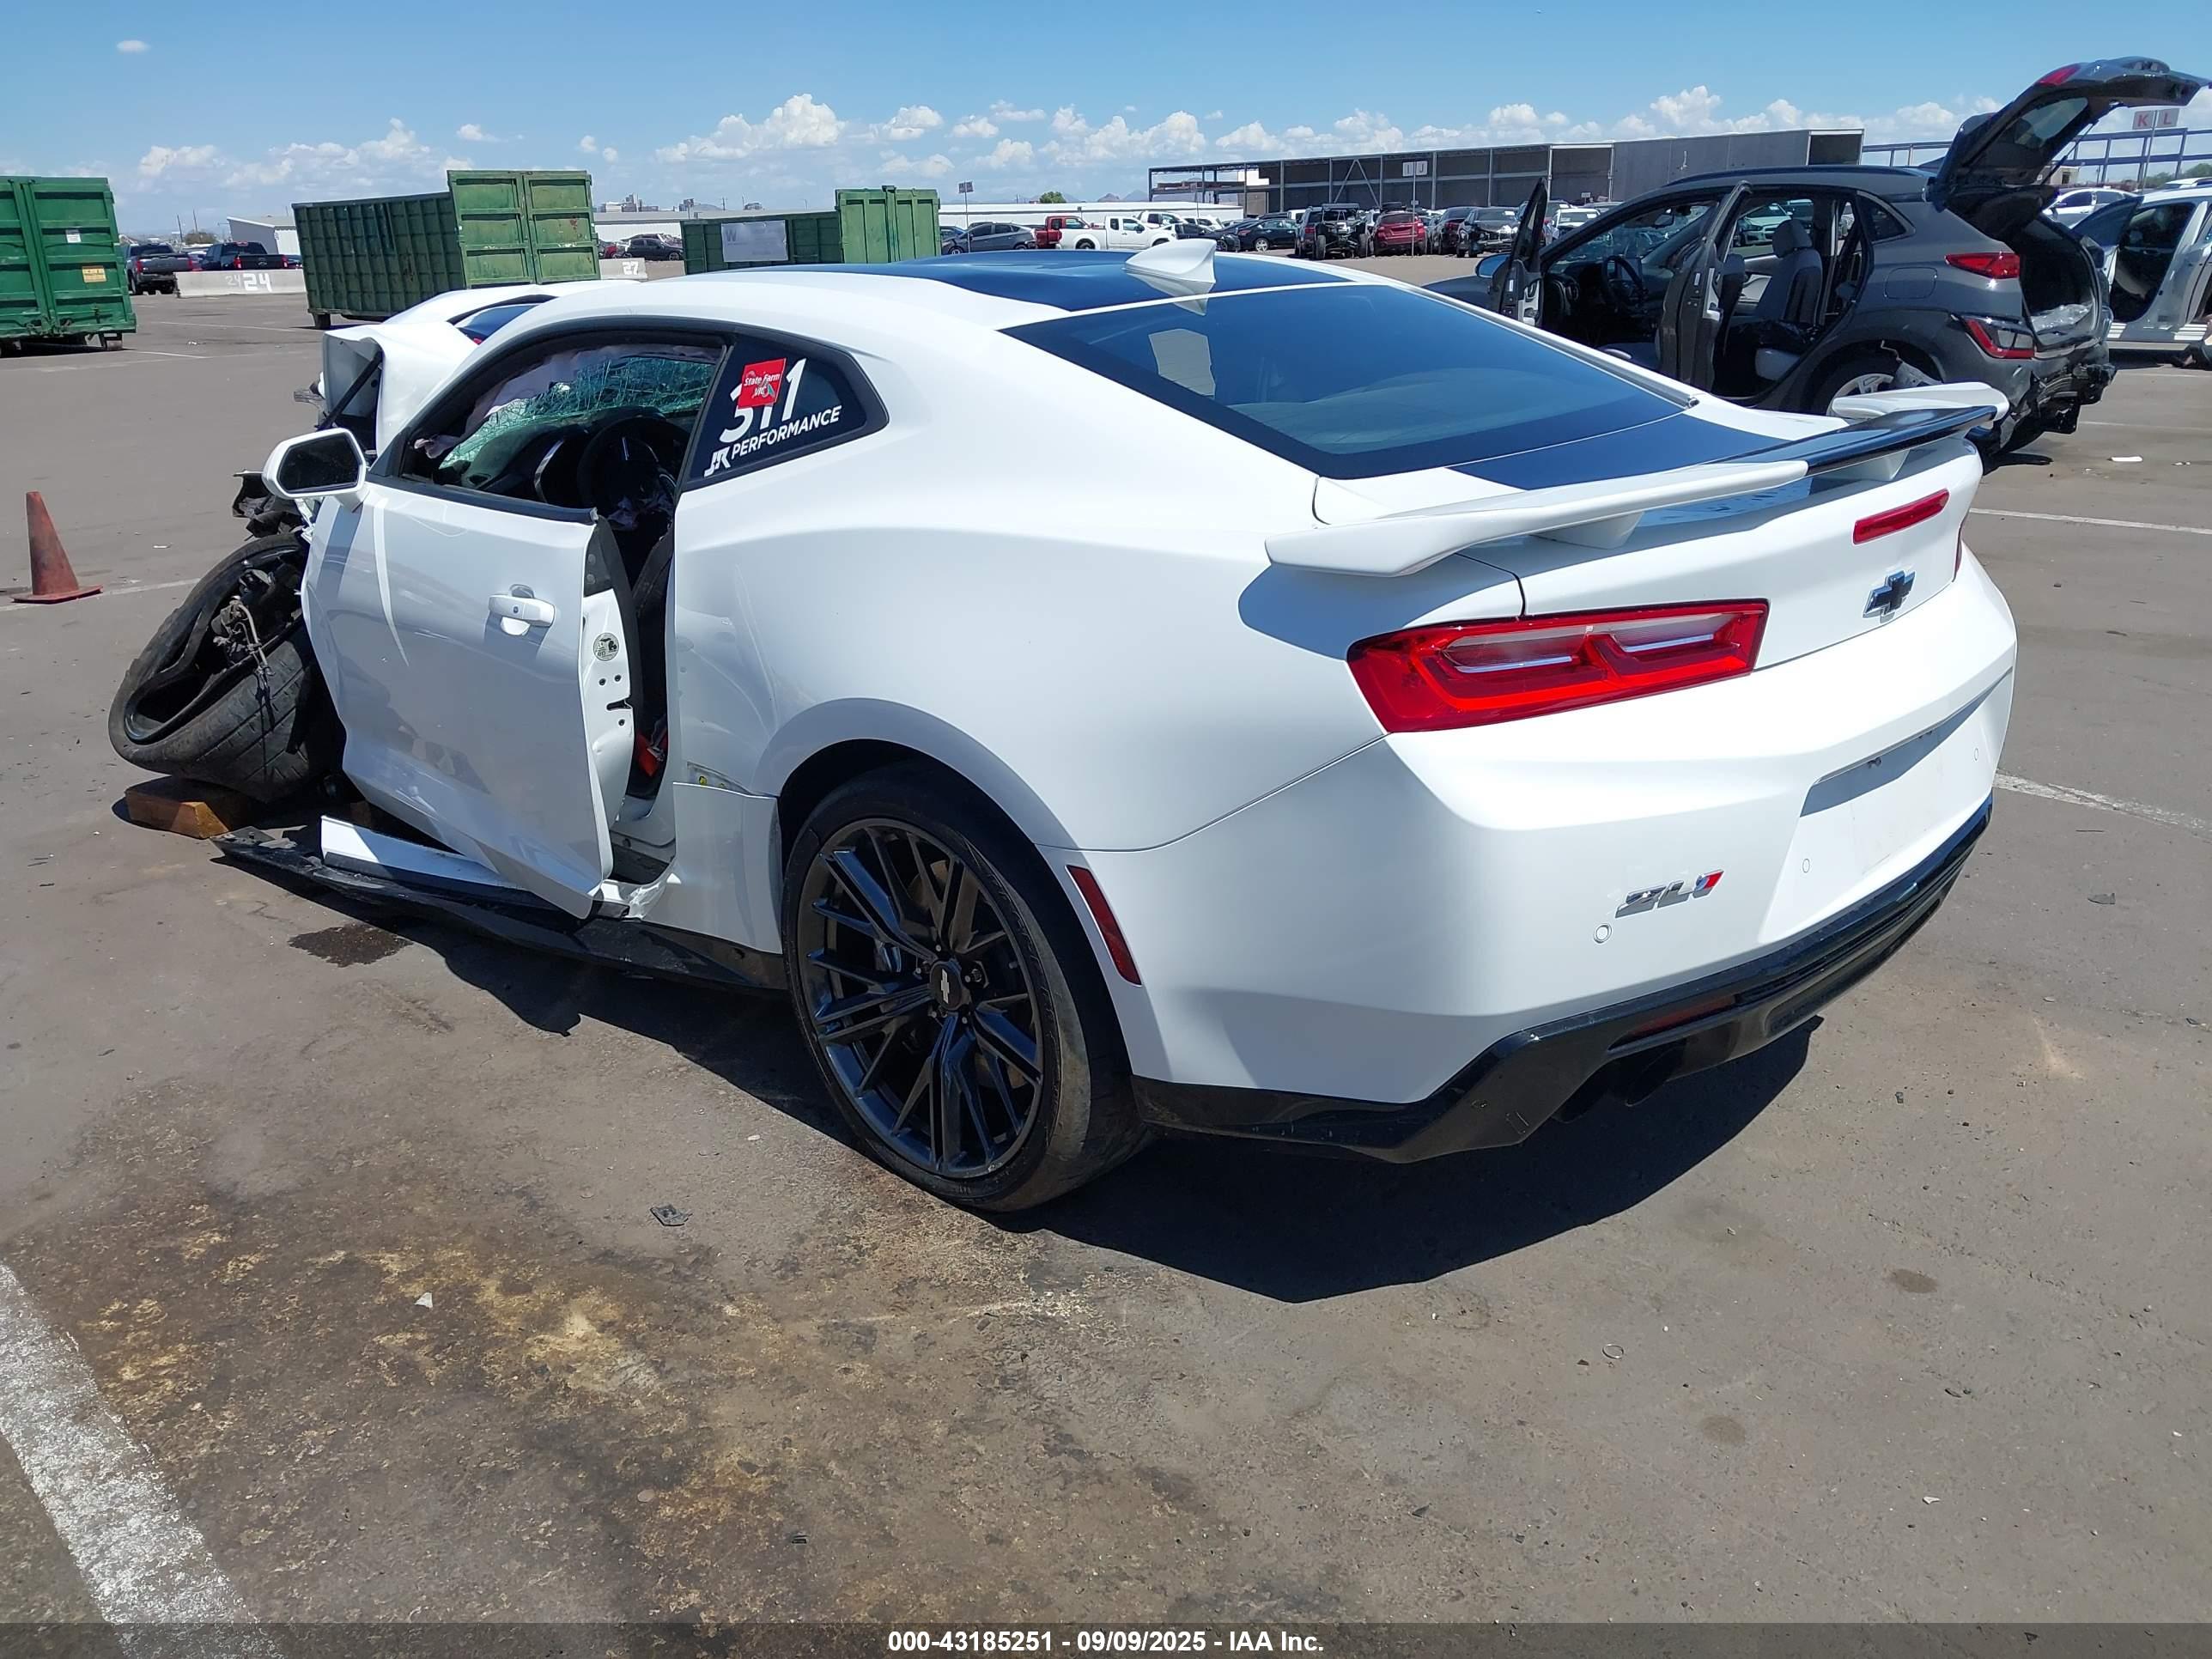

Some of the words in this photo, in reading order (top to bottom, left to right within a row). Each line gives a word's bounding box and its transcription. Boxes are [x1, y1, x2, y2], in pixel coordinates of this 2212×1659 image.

[2137, 113, 2149, 127] K
[2163, 112, 2172, 125] L
[623, 261, 639, 276] 27
[243, 272, 273, 293] 24
[744, 376, 763, 386] State
[763, 373, 781, 385] Farm
[732, 404, 842, 459] PERFORMANCE
[1614, 869, 1724, 919] ZL1
